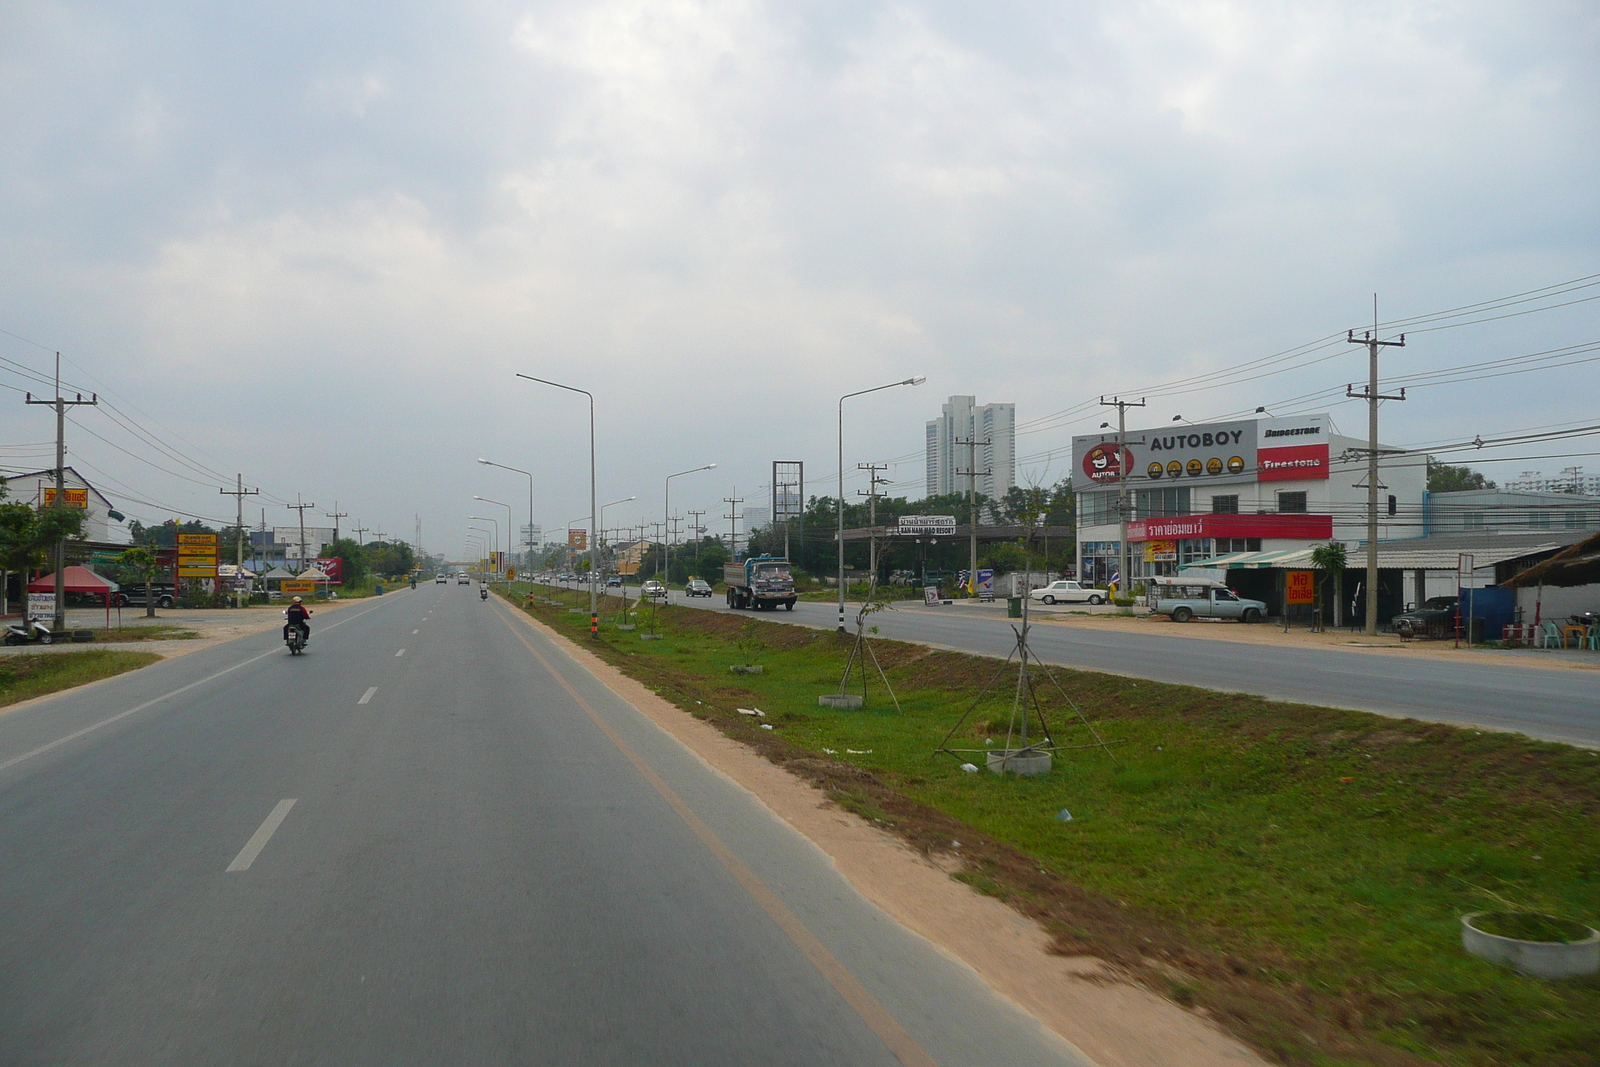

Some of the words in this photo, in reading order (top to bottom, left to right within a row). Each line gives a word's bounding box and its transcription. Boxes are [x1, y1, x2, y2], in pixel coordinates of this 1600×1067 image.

[1264, 426, 1321, 438] BRIDGESTONE
[1150, 429, 1243, 452] AUTOBOY
[1263, 458, 1321, 470] Firestone
[936, 526, 954, 535] RESORT
[1148, 518, 1203, 537] ราคาย่อมเยาว์
[1292, 572, 1308, 586] ท่อ
